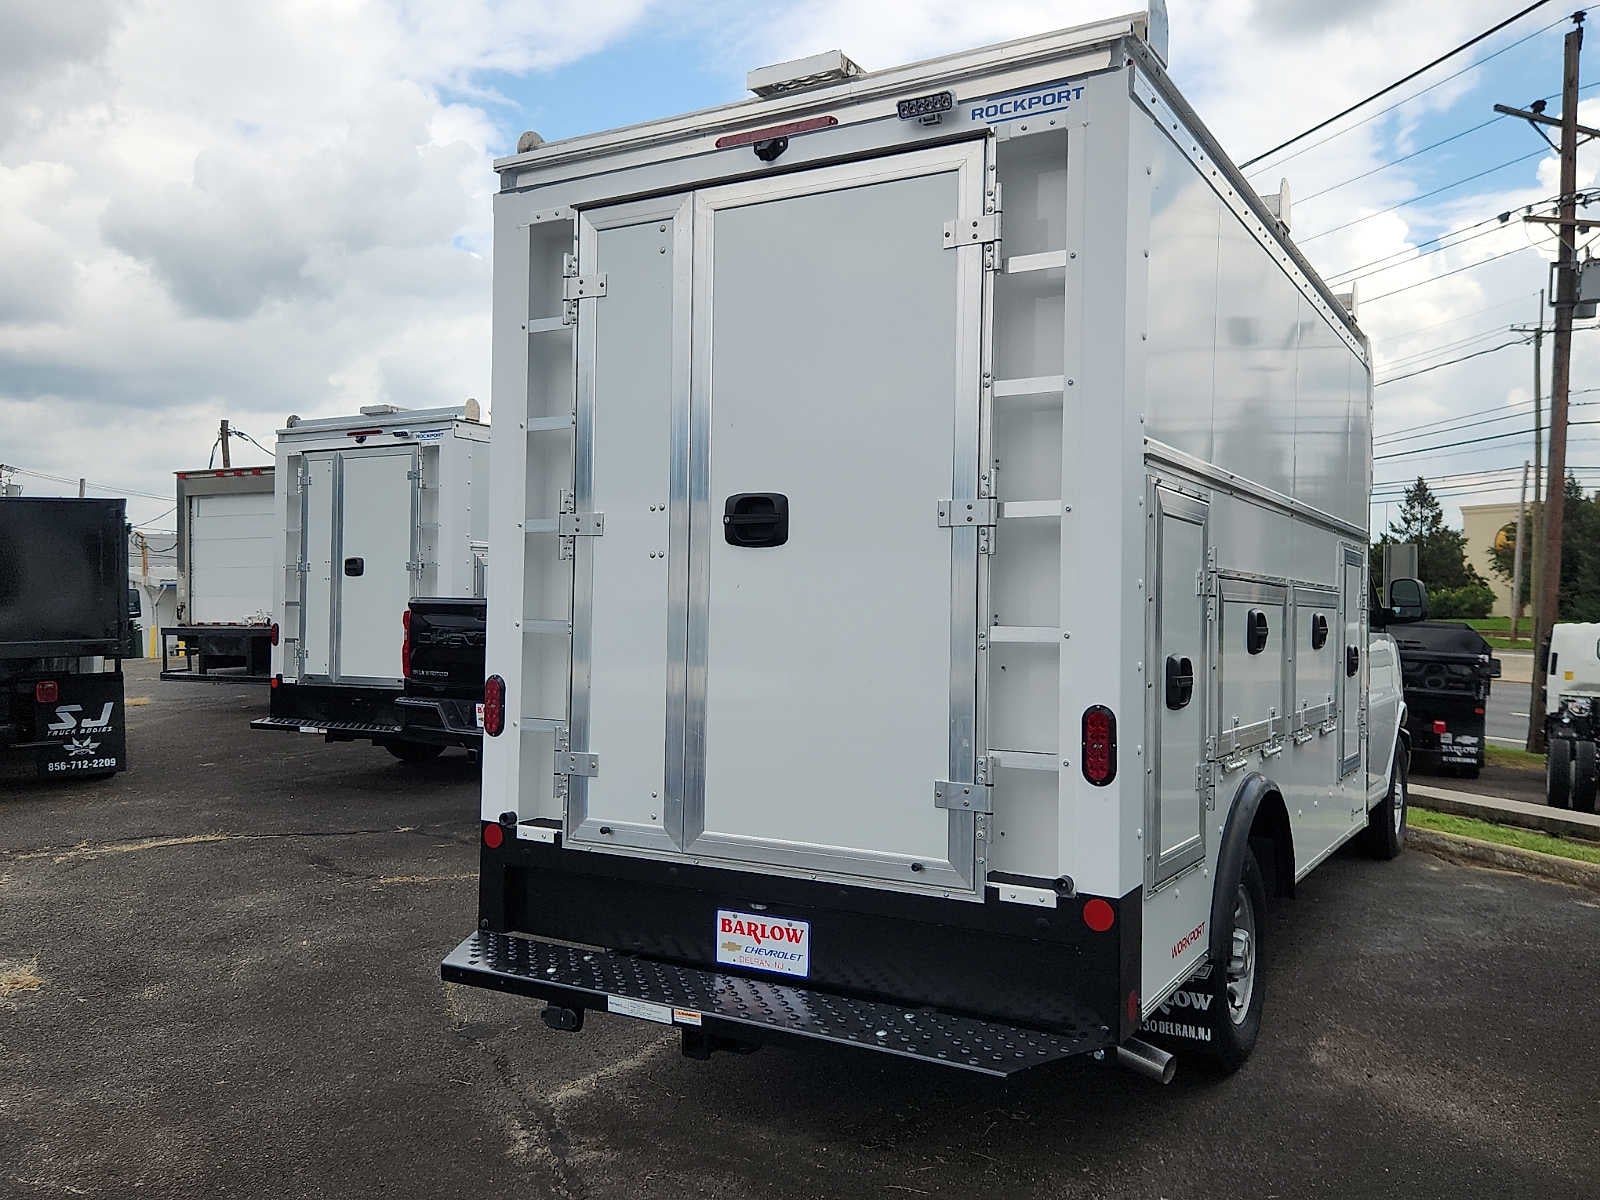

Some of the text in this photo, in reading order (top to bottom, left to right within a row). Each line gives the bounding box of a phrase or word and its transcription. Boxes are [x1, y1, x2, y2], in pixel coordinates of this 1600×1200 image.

[971, 87, 1085, 120] ROCKPORT
[48, 702, 114, 730] SJ
[48, 758, 116, 771] 856-712-2209
[721, 918, 804, 945] BARLOW
[1171, 921, 1205, 959] WORKPORT
[744, 945, 804, 962] CHEVROLET
[1140, 1020, 1157, 1033] 30
